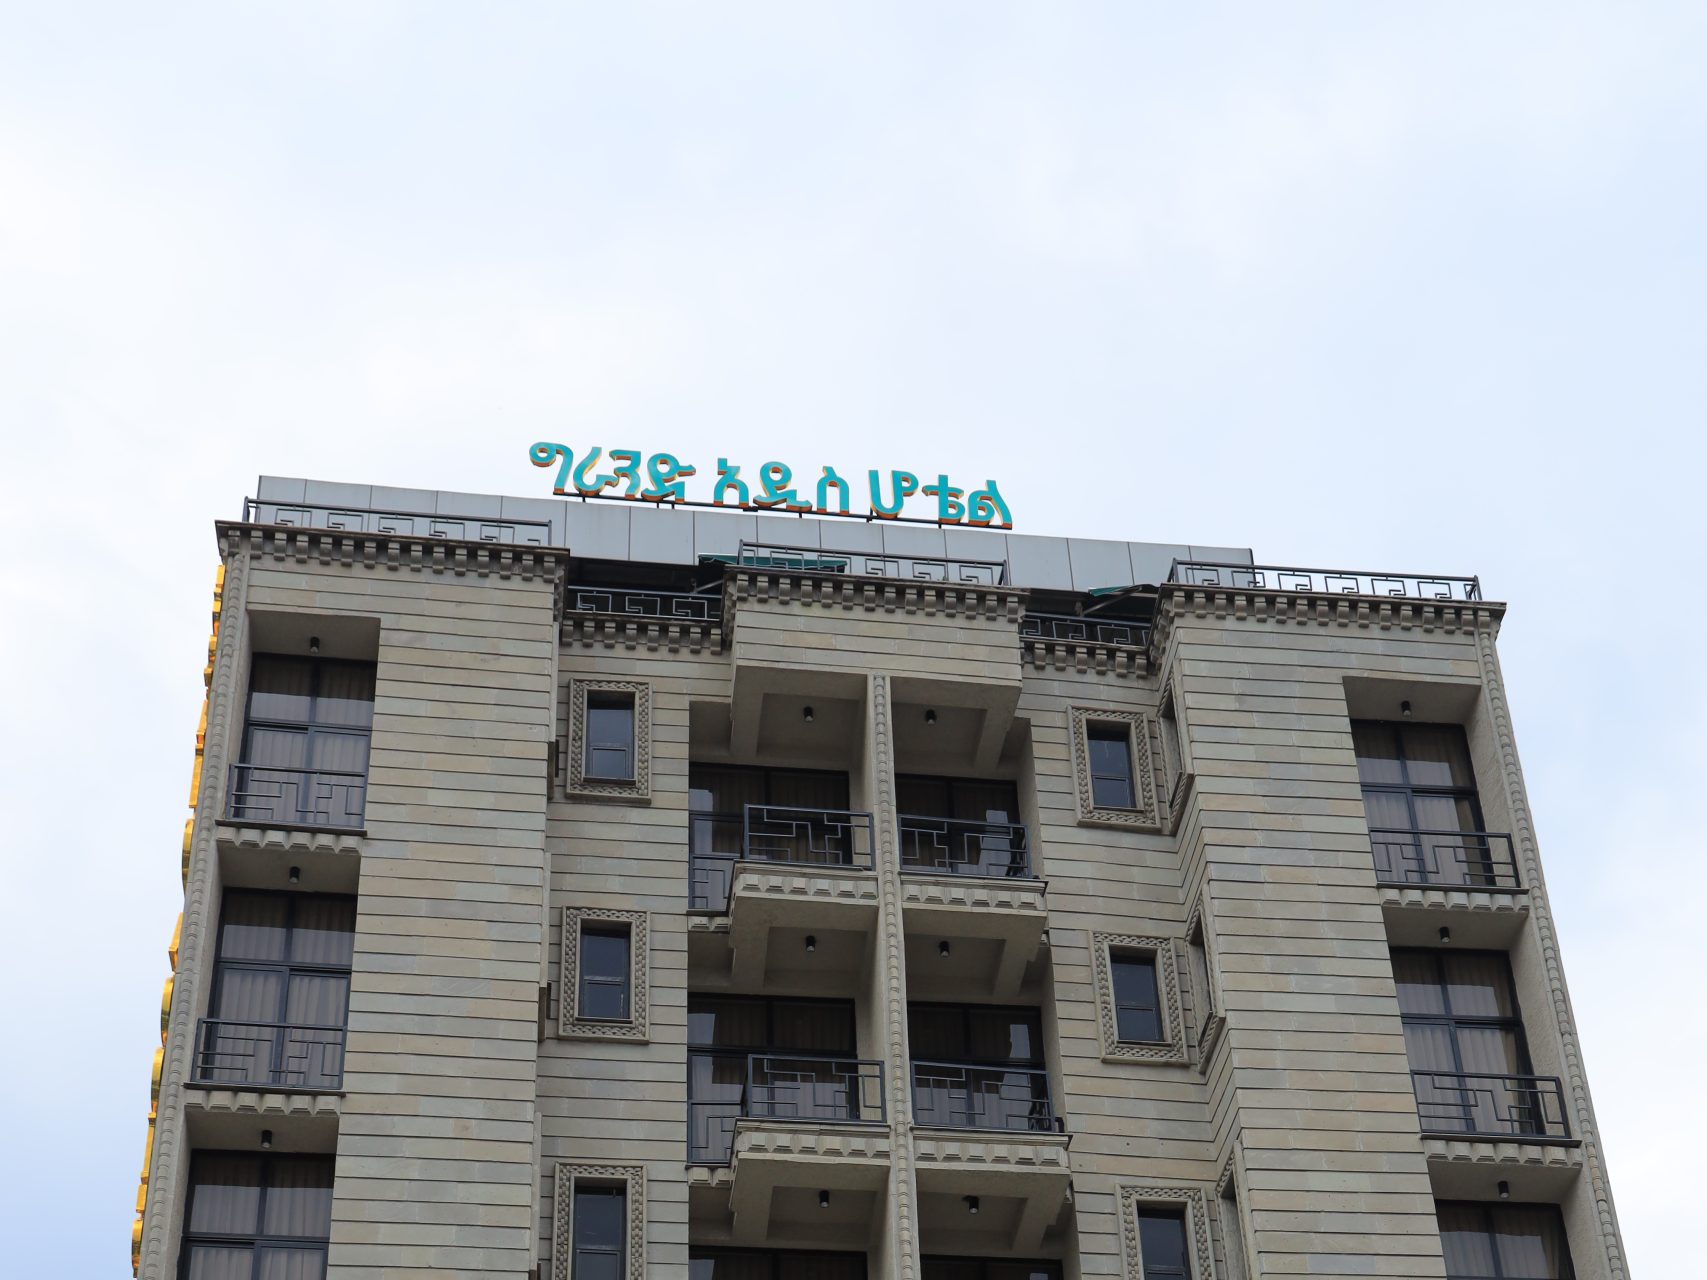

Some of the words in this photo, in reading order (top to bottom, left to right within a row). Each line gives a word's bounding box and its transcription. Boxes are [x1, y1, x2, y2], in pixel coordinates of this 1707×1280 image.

[529, 442, 696, 503] ግራንድ
[713, 457, 850, 515] አዲስ
[868, 469, 1012, 529] ሆቴል
